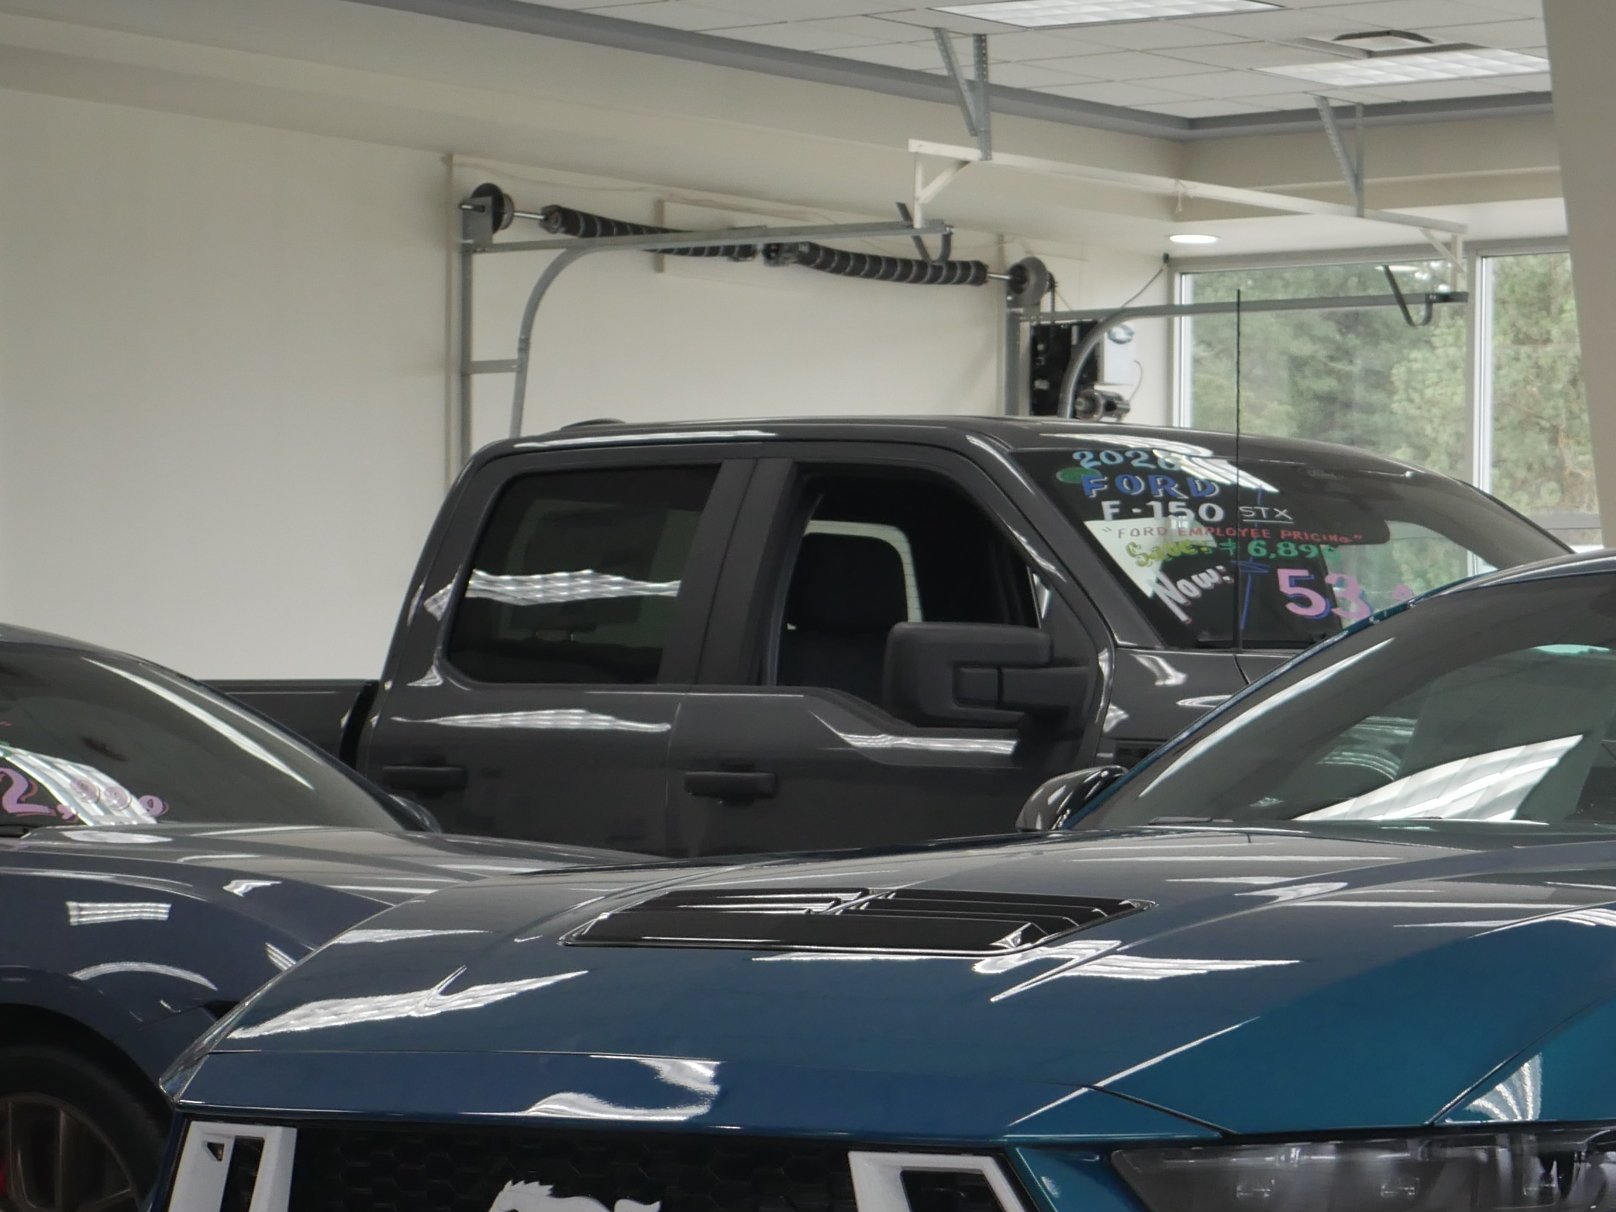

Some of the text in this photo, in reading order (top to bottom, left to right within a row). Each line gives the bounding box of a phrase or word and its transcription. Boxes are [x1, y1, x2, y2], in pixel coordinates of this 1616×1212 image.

[1081, 474, 1220, 499] FORD
[1101, 500, 1294, 522] F-150 STX
[1178, 527, 1271, 539] EMPLOYEE
